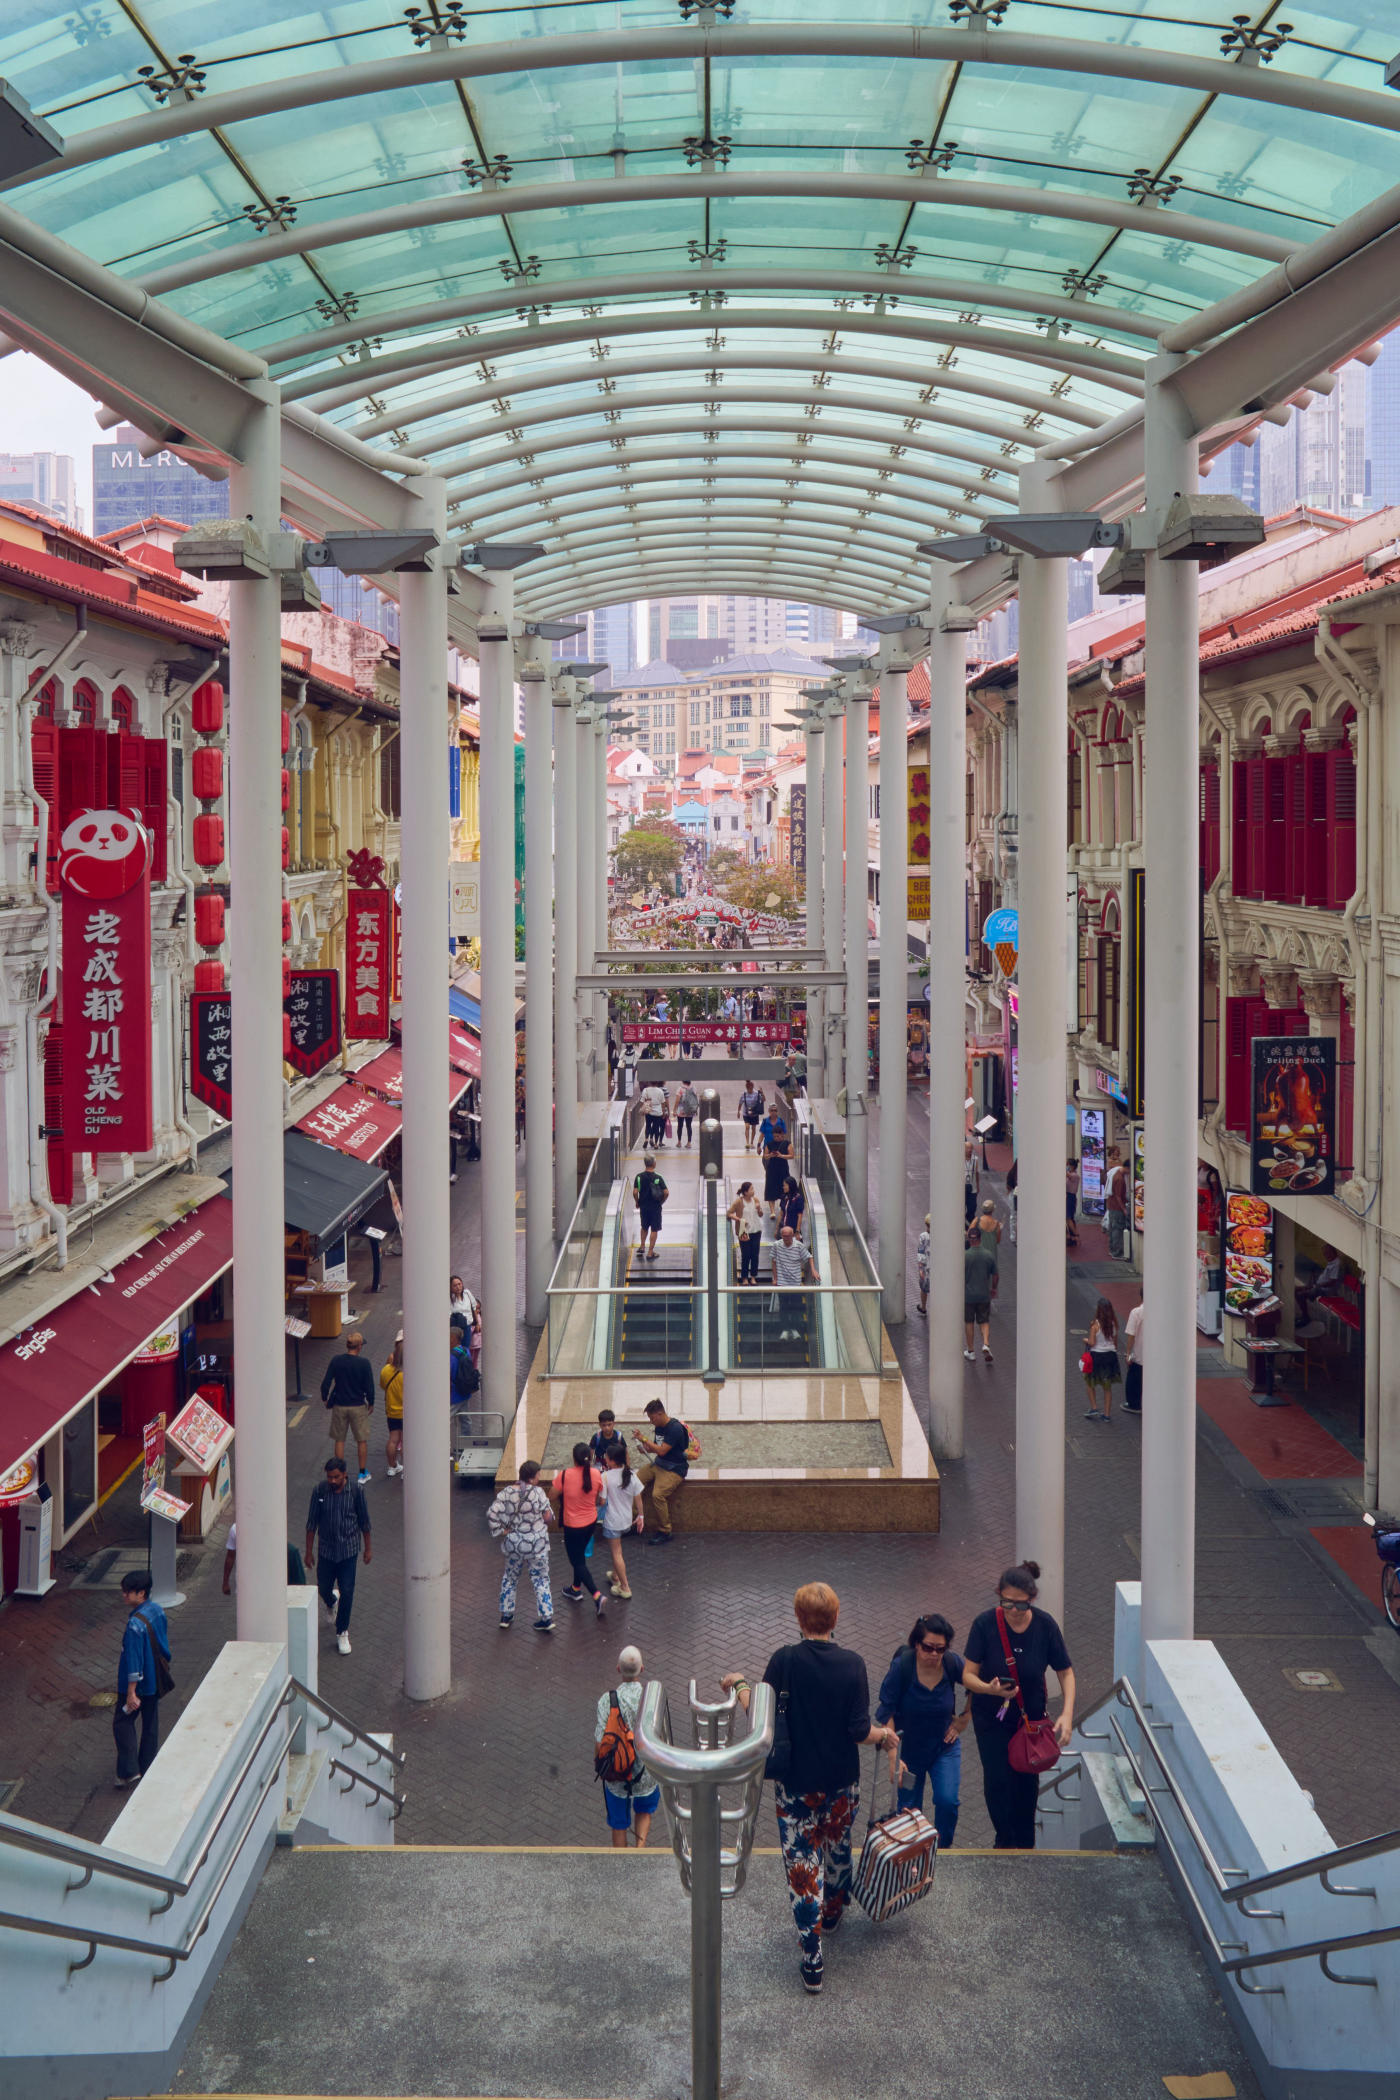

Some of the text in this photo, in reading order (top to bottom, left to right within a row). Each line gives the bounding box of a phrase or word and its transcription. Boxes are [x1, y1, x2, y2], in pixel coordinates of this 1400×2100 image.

[355, 911, 380, 1016] 东方美食
[82, 908, 125, 1102] 老成都川菜
[290, 980, 311, 1045] 湘西故里
[648, 1027, 663, 1035] LIM
[688, 1027, 711, 1035] GUAN
[727, 1026, 767, 1039] 林志源
[207, 1003, 232, 1083] 湘西故里
[84, 1106, 106, 1115] OLD
[84, 1116, 123, 1125] CHENG
[84, 1125, 101, 1135] DU
[122, 1286, 137, 1298] OLD
[14, 1327, 57, 1361] SingGas
